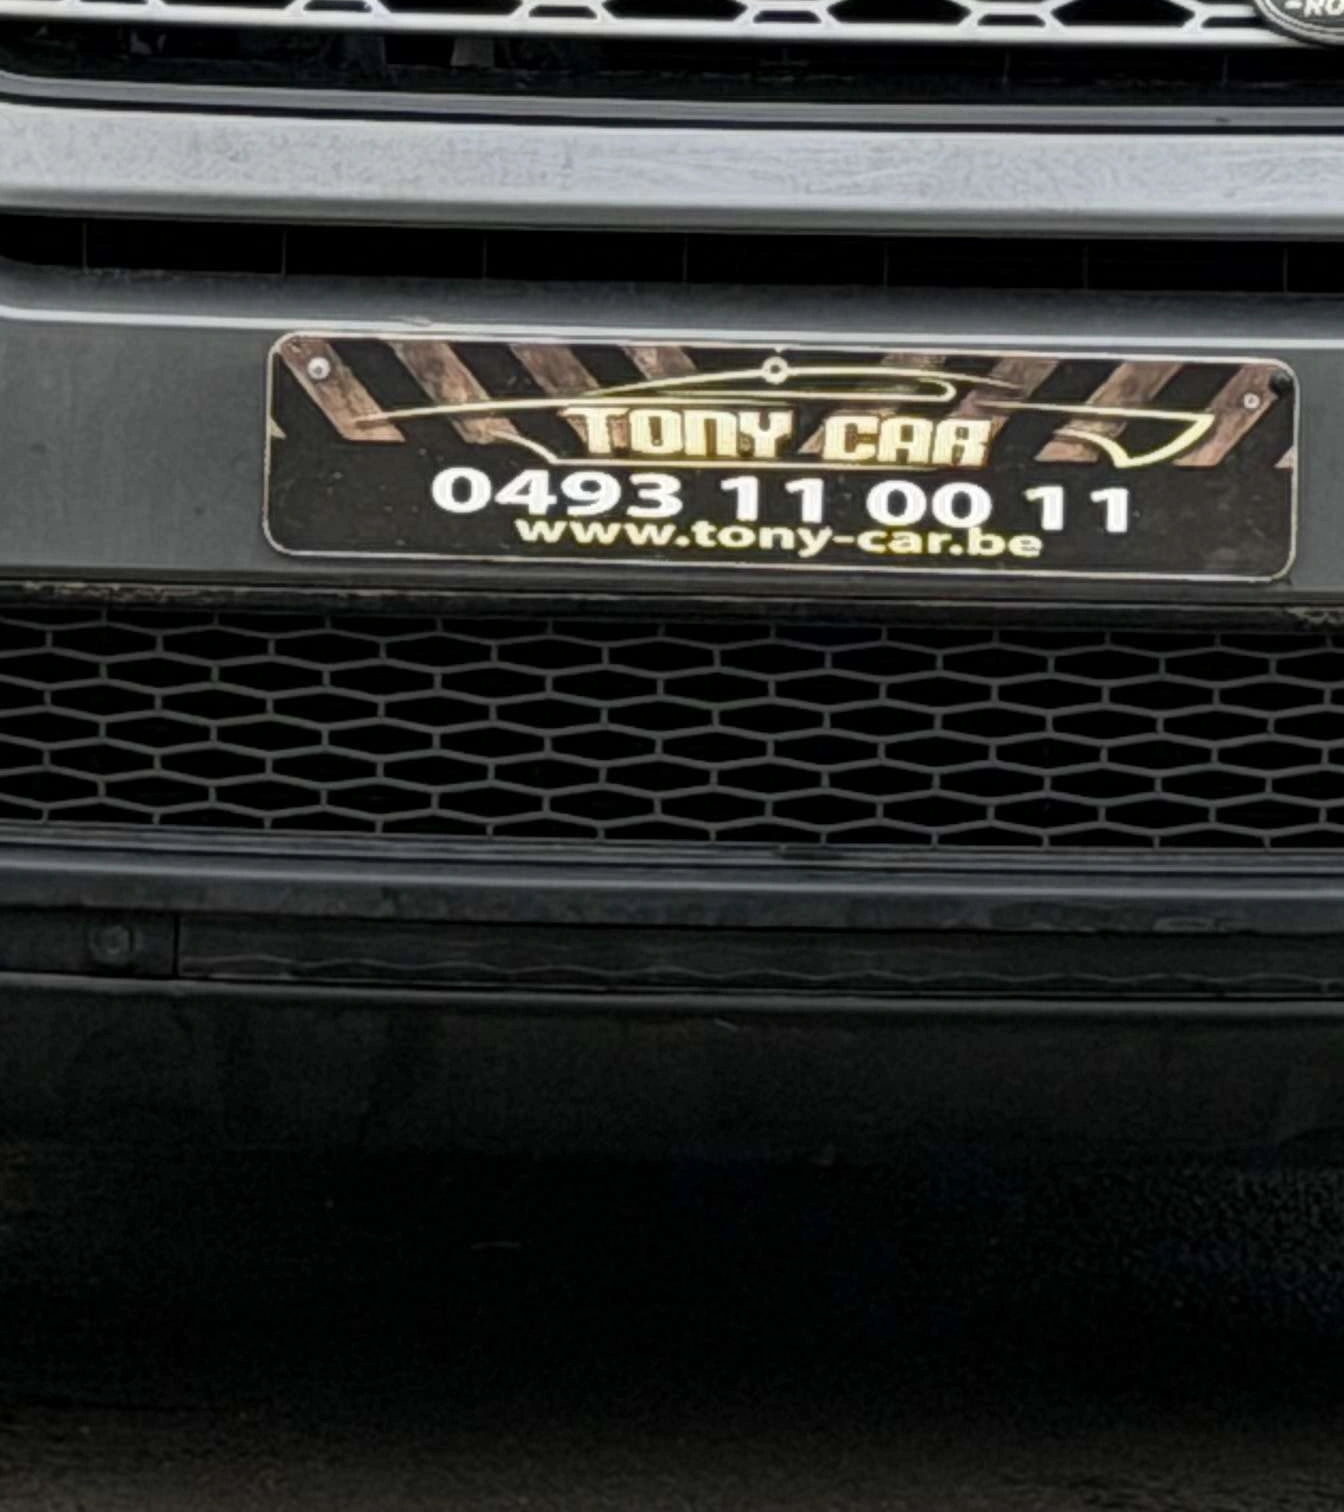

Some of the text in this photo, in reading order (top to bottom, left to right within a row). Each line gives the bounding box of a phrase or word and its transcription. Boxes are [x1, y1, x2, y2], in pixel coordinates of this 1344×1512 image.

[563, 407, 993, 465] TONY CAR
[431, 466, 1130, 534] 0493 11 00 11
[514, 517, 1044, 558] www.tony-car.be
